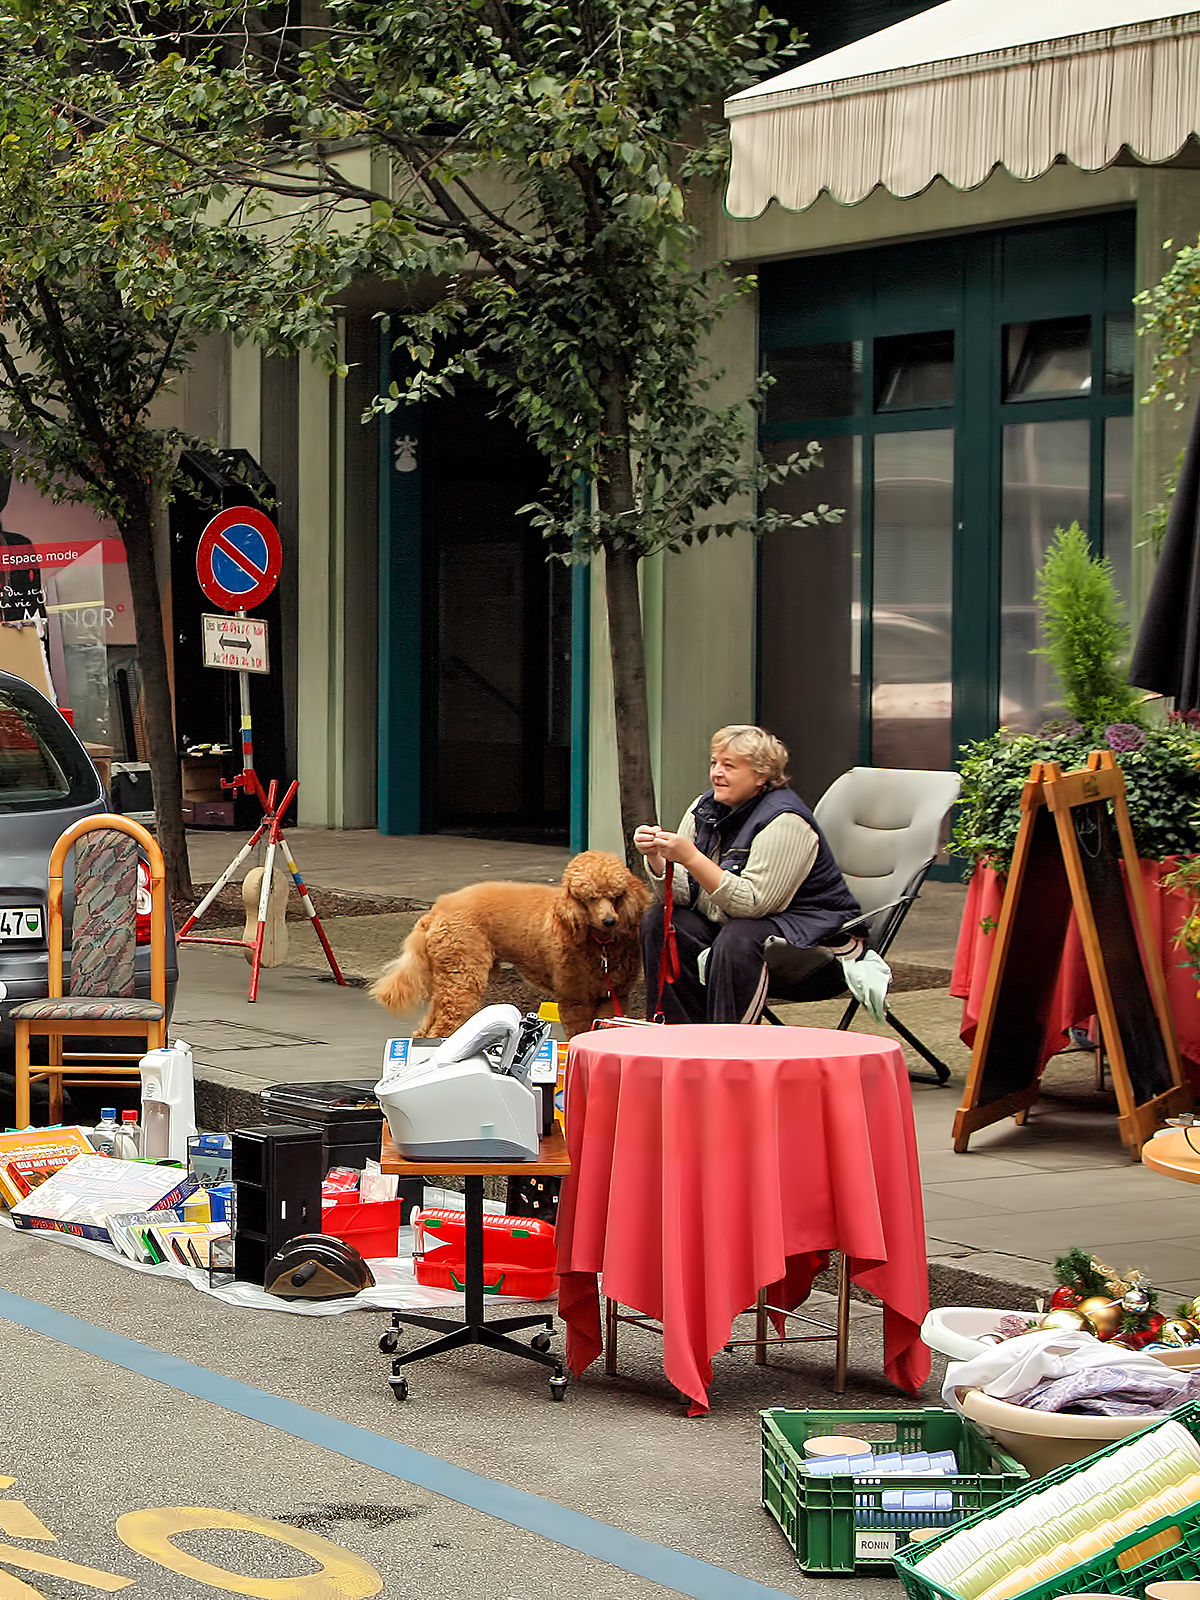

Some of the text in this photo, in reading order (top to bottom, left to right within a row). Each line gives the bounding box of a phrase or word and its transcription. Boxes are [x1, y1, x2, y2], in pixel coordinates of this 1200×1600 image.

[2, 553, 43, 565] Espace
[46, 550, 79, 561] mode
[0, 601, 12, 609] la
[22, 608, 114, 628] MNOR
[861, 1540, 889, 1550] RONIN
